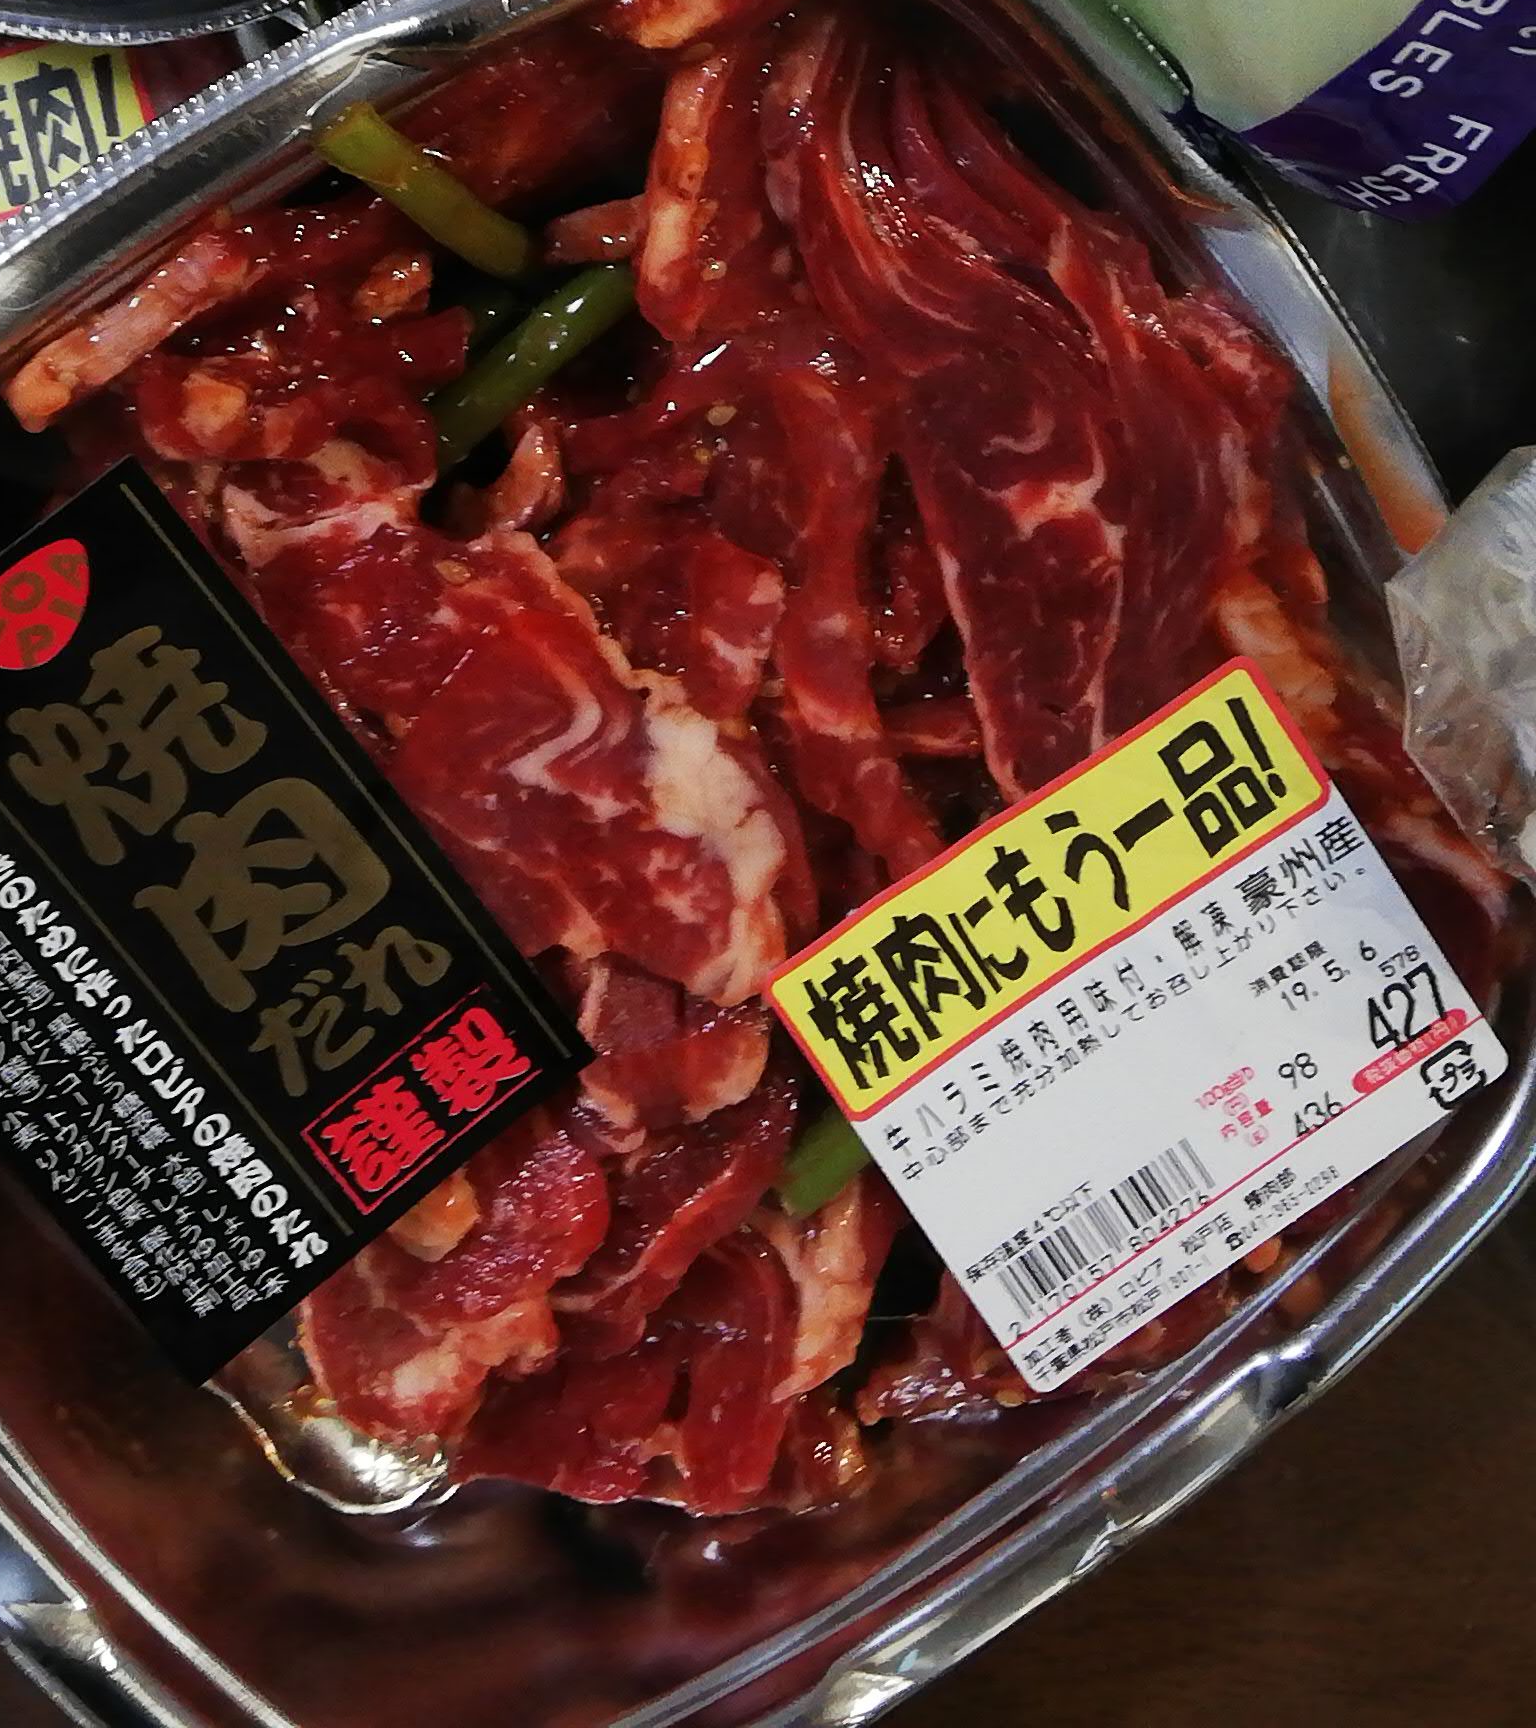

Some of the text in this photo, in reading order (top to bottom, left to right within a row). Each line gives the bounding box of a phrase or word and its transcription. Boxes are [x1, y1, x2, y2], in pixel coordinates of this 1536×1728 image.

[1335, 111, 1494, 210] FRESH
[800, 695, 1288, 1092] 焼肉にもう一品！
[1249, 940, 1327, 998] 消費期限
[1378, 944, 1421, 978] 578
[1367, 962, 1448, 1052] 427
[1278, 1052, 1318, 1090] 98
[1294, 1091, 1344, 1138] 436
